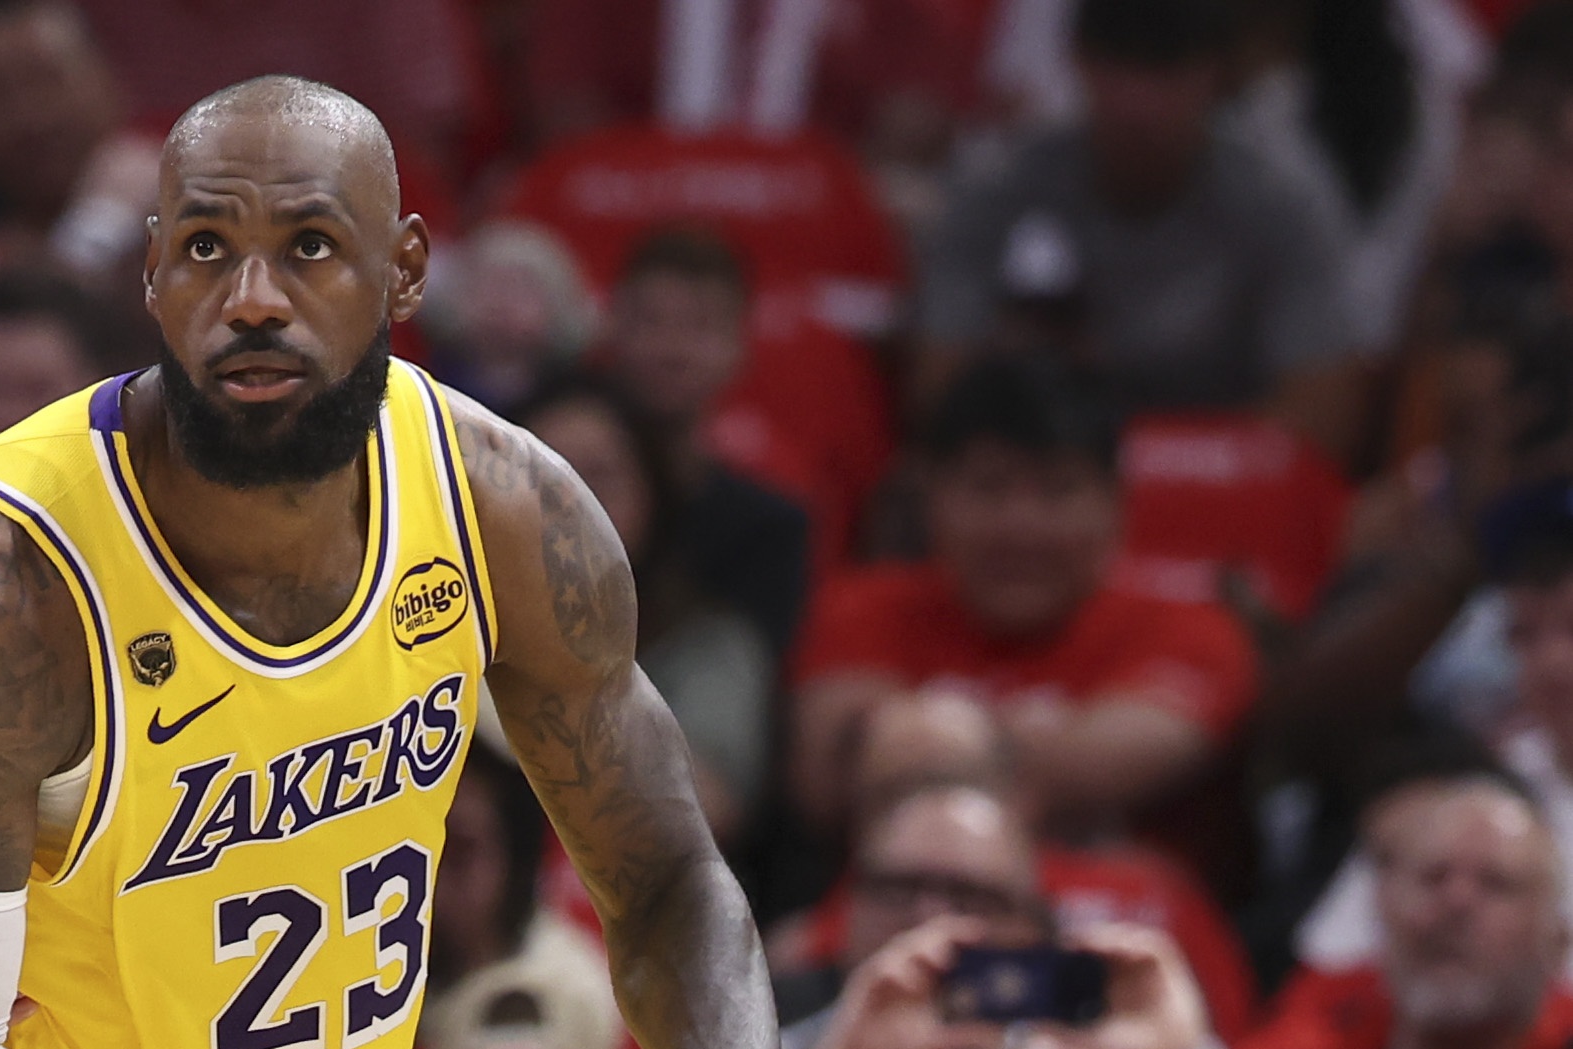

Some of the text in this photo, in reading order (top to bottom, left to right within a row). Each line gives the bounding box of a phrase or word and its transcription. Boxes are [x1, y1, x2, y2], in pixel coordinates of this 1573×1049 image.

[395, 580, 463, 626] bibigo
[405, 609, 435, 632] 비비고
[130, 634, 167, 651] LEGACY
[117, 672, 467, 898] LAKERS
